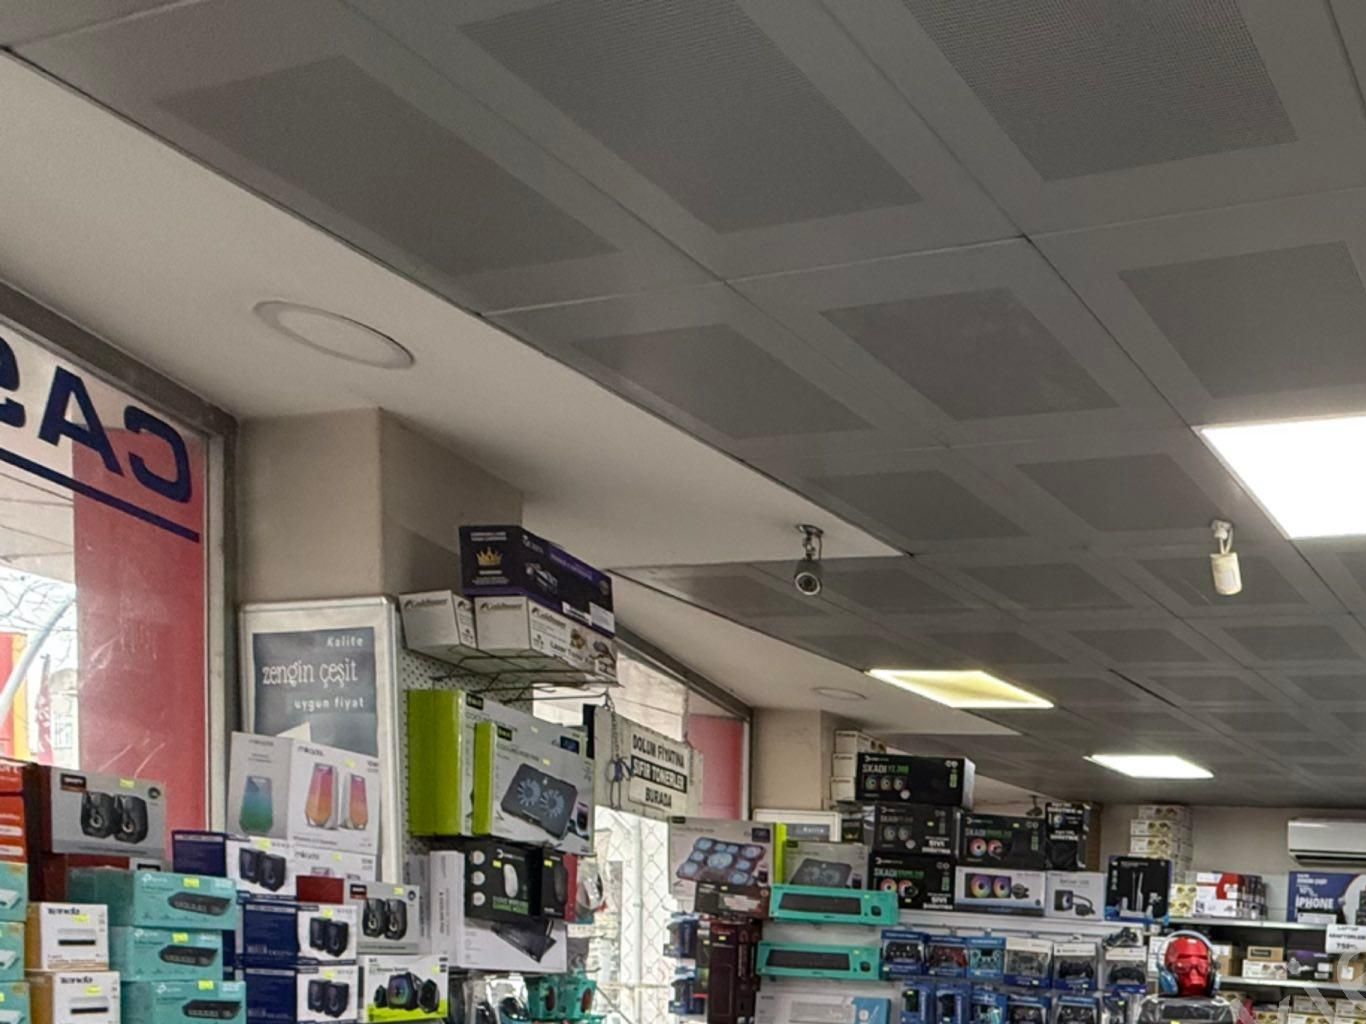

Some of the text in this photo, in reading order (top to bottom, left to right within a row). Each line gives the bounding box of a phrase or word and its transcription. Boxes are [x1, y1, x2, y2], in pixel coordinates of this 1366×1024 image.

[326, 636, 364, 648] Kalite
[262, 658, 358, 688] zengin çeşit
[293, 696, 364, 711] uygun fiyat
[632, 733, 656, 758] DOLUM
[645, 786, 672, 809] BURADA
